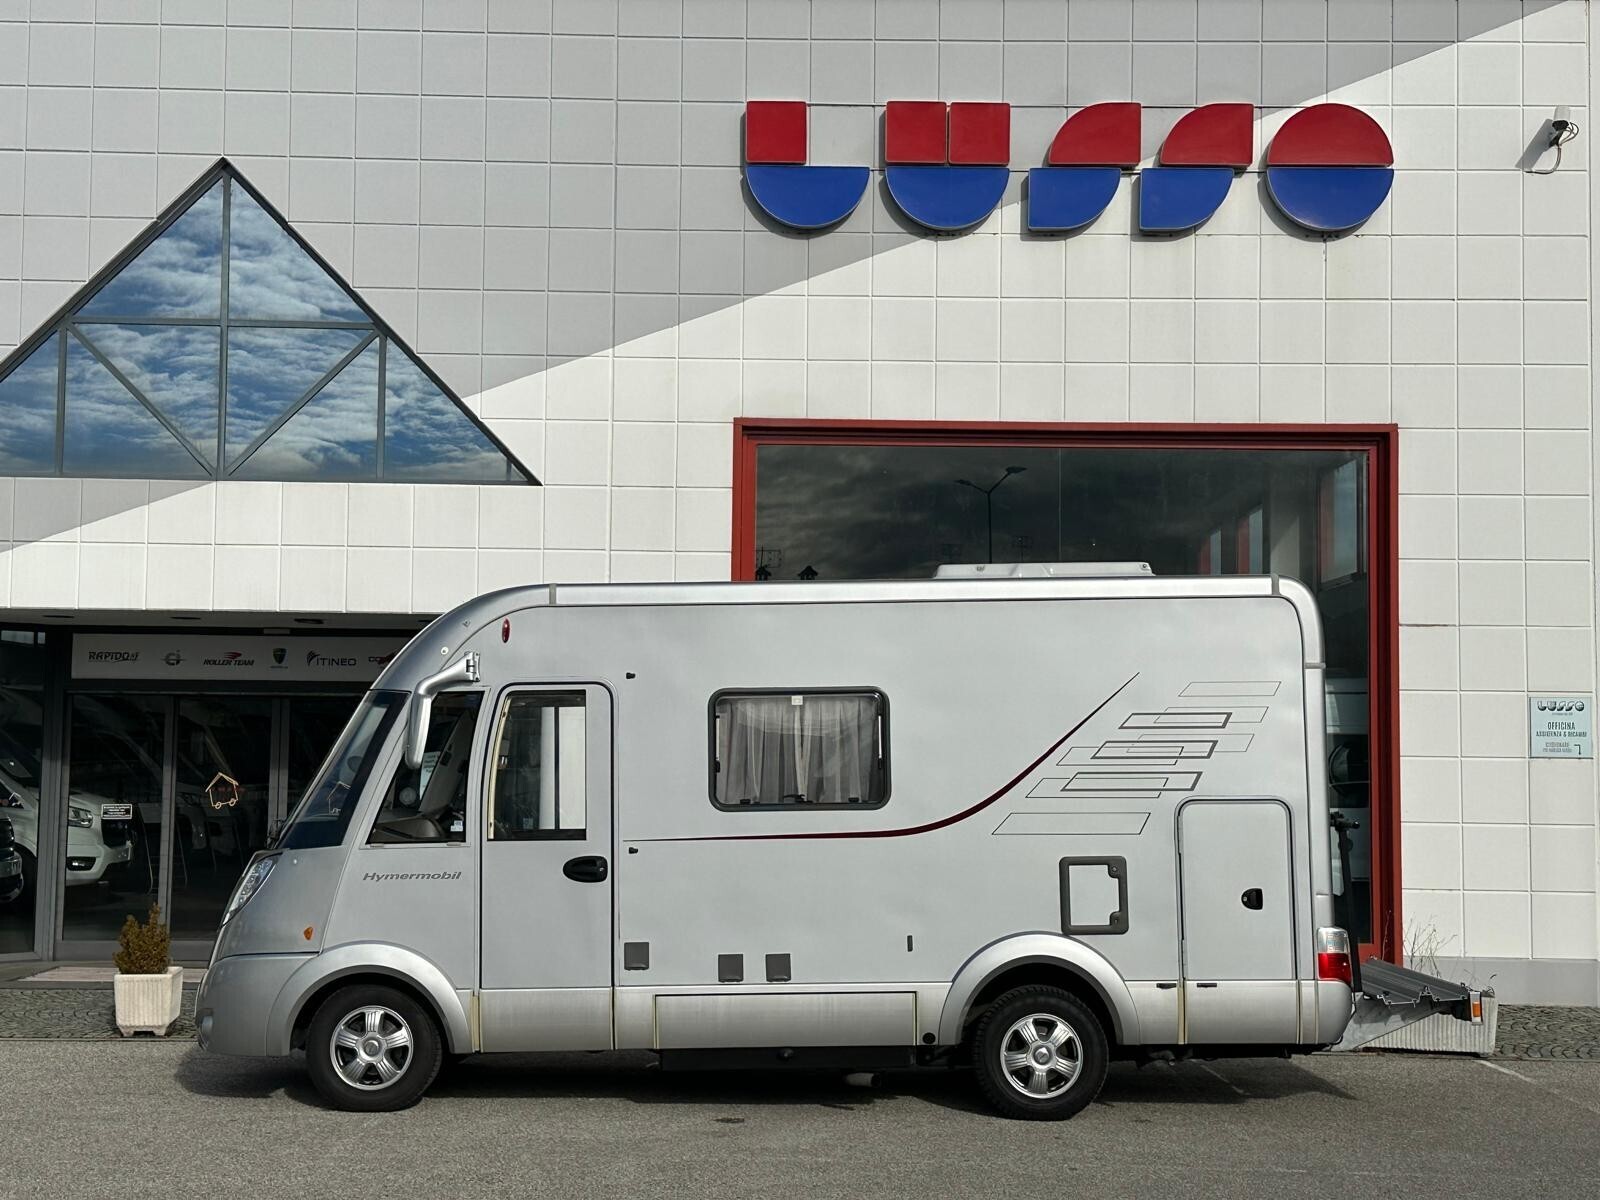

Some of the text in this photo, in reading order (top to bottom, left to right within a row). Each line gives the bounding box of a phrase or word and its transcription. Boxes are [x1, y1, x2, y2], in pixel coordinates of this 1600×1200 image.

[745, 100, 1394, 232] LUSSO
[88, 651, 130, 661] RAPIDO
[203, 658, 255, 666] ROLLER TEAM
[1537, 701, 1584, 711] LUSSO
[1548, 722, 1575, 730] OFFICINA
[362, 871, 462, 882] Hymermobil
